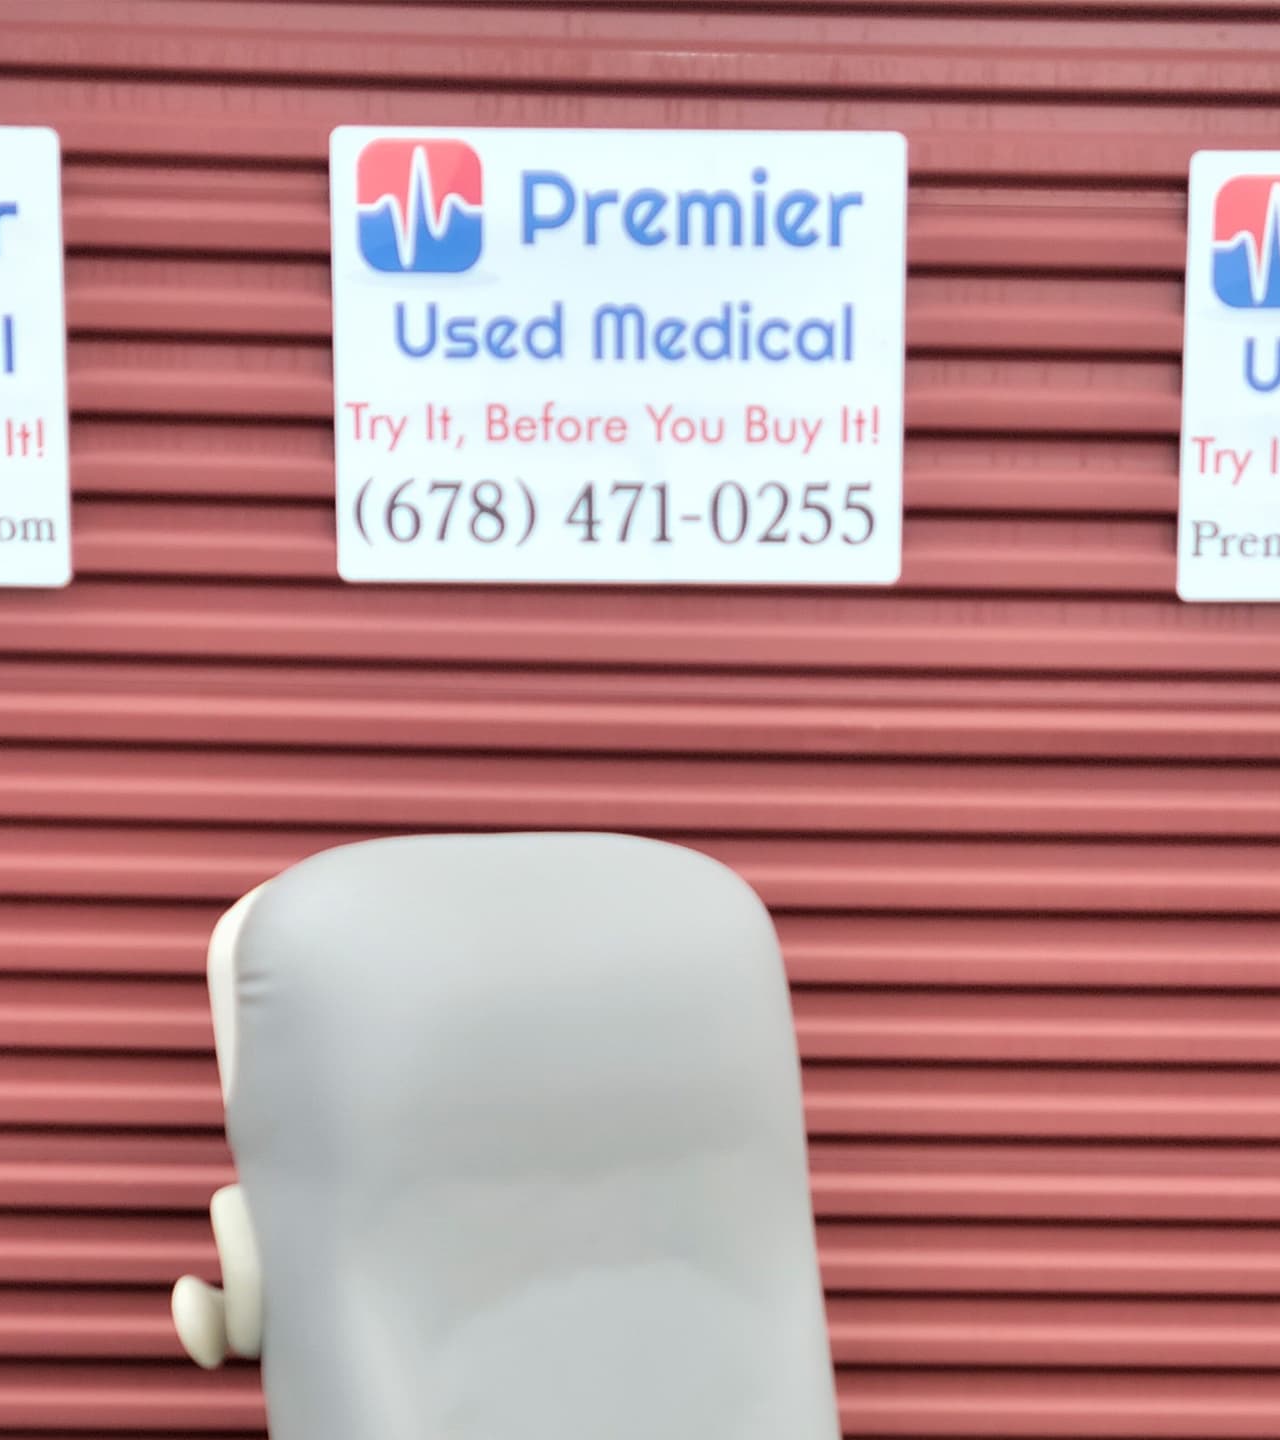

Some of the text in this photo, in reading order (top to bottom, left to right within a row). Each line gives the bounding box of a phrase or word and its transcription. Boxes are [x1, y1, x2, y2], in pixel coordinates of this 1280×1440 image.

[521, 168, 863, 248] Premier
[395, 301, 852, 362] Used Medical
[6, 419, 43, 456] It!
[346, 402, 878, 453] Try It, Before You Buy It!
[1192, 437, 1251, 484] Try
[353, 477, 875, 546] (678) 471-0255
